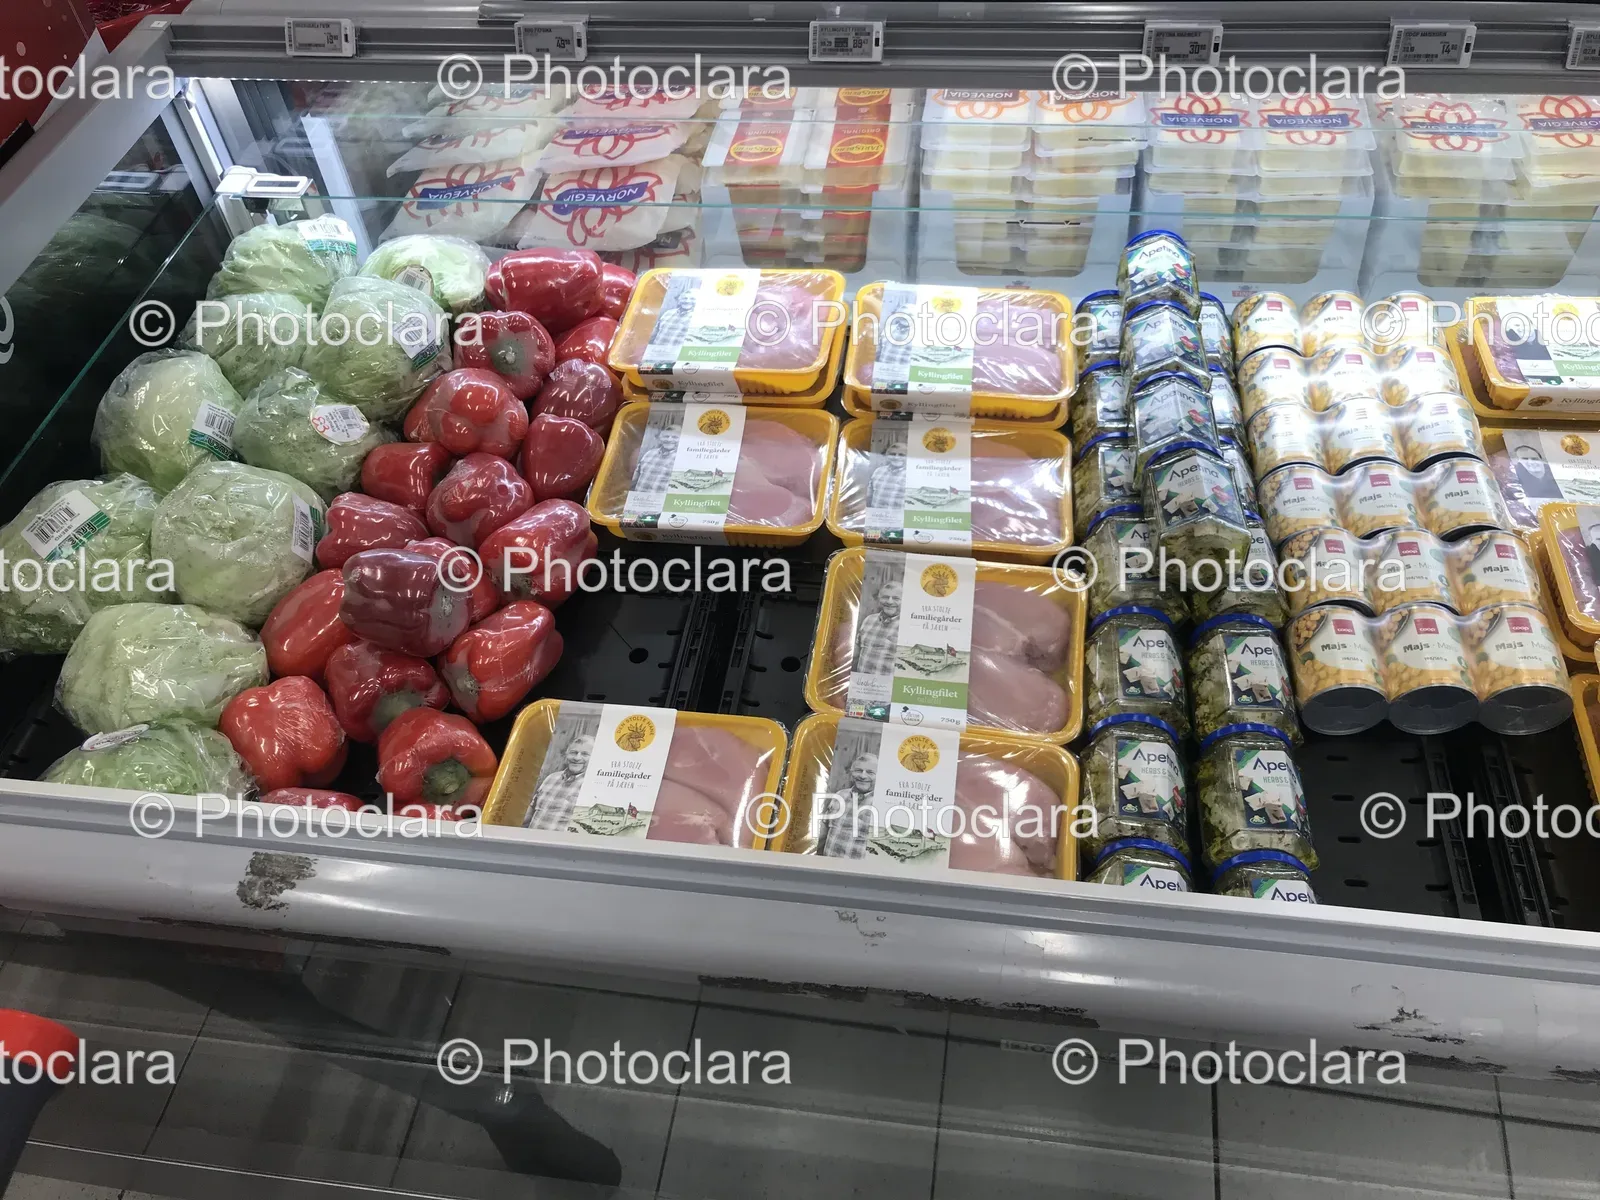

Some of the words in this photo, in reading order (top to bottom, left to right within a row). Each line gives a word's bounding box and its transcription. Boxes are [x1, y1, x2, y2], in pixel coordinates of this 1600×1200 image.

[1167, 116, 1233, 124] NORVEGIA
[1273, 117, 1343, 125] NORVEGIA
[1537, 120, 1600, 129] ORVEGIA
[1139, 245, 1180, 260] Apetina
[687, 349, 732, 360] Kyllingfilet
[917, 370, 964, 381] Kyllingfilet
[677, 379, 724, 389] Kyllingfilet
[907, 401, 956, 410] Kyllingfilet
[1359, 493, 1382, 504] Majs
[1445, 489, 1470, 500] Majs
[673, 499, 721, 508] Kyllingfilet
[1283, 495, 1306, 506] Majs
[912, 516, 963, 525] Kyllingfilet
[1483, 565, 1510, 574] Majs
[910, 613, 962, 624] familiegårder
[1321, 642, 1347, 651] Majs
[1403, 642, 1430, 653] Majs
[1495, 641, 1524, 651] Majs
[903, 685, 958, 699] Kyllingfilet
[623, 761, 642, 770] STOLTE
[596, 769, 652, 780] familiegårder
[607, 779, 615, 788] PÅ
[616, 780, 634, 789] JÆREN
[911, 781, 931, 791] STOLTE
